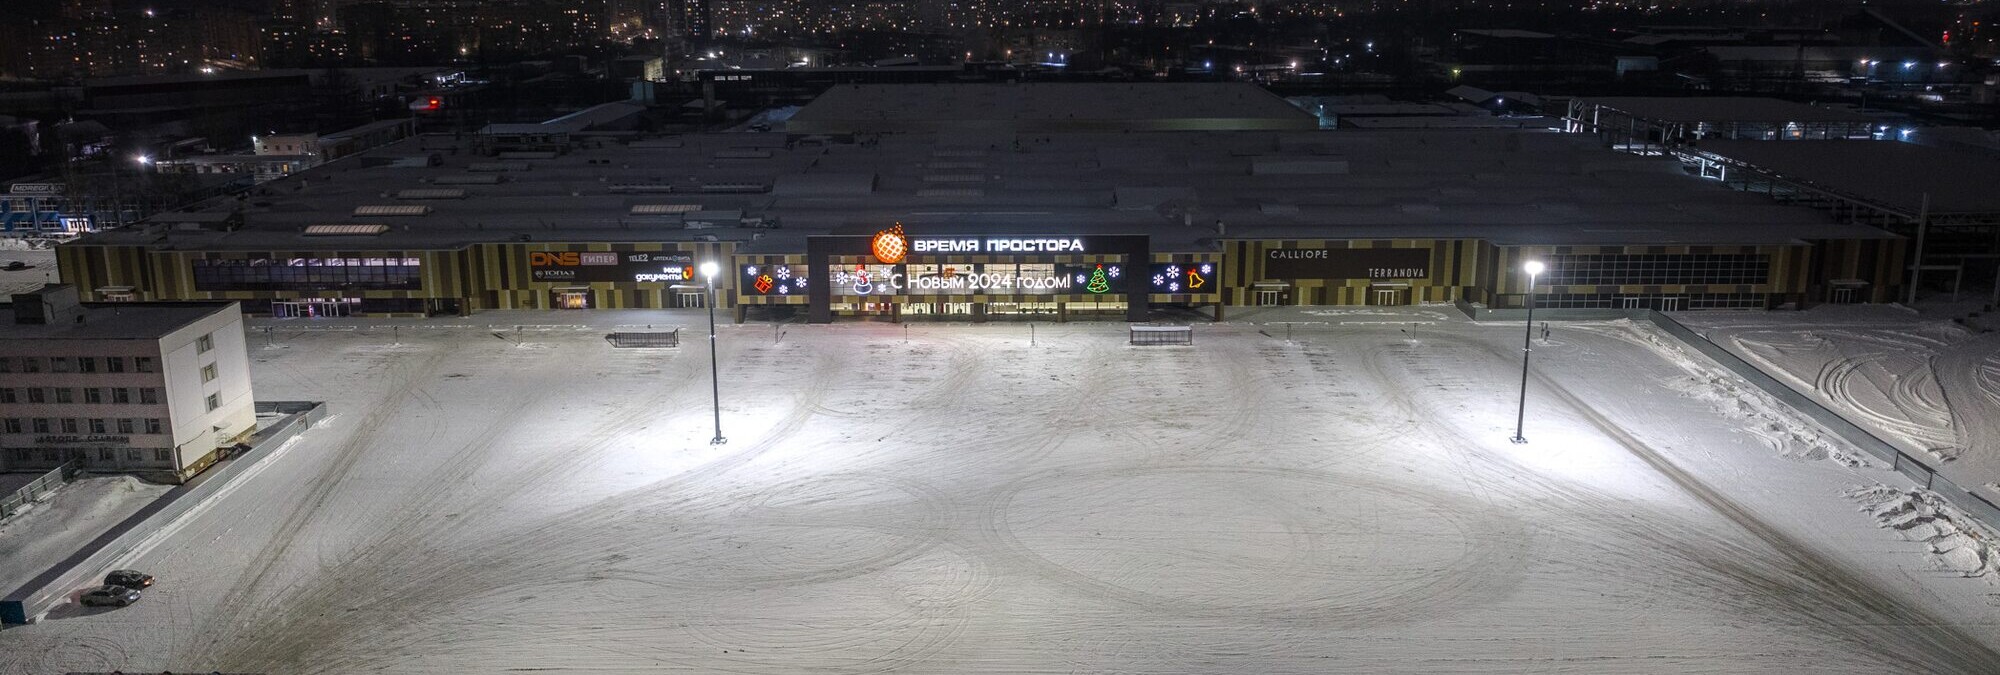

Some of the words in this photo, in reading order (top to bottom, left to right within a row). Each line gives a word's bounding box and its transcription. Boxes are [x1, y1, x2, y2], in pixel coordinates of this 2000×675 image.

[914, 240, 979, 251] ВРЕМЯ
[986, 239, 1084, 251] ПРОСТОРА
[531, 252, 580, 266] DNS
[583, 254, 615, 264] ГИПЕР
[629, 254, 649, 262] TELE2
[1270, 250, 1328, 259] CALLIOPE
[1369, 268, 1424, 277] TERRANOVA
[890, 275, 902, 289] С
[968, 274, 1013, 289] 2024
